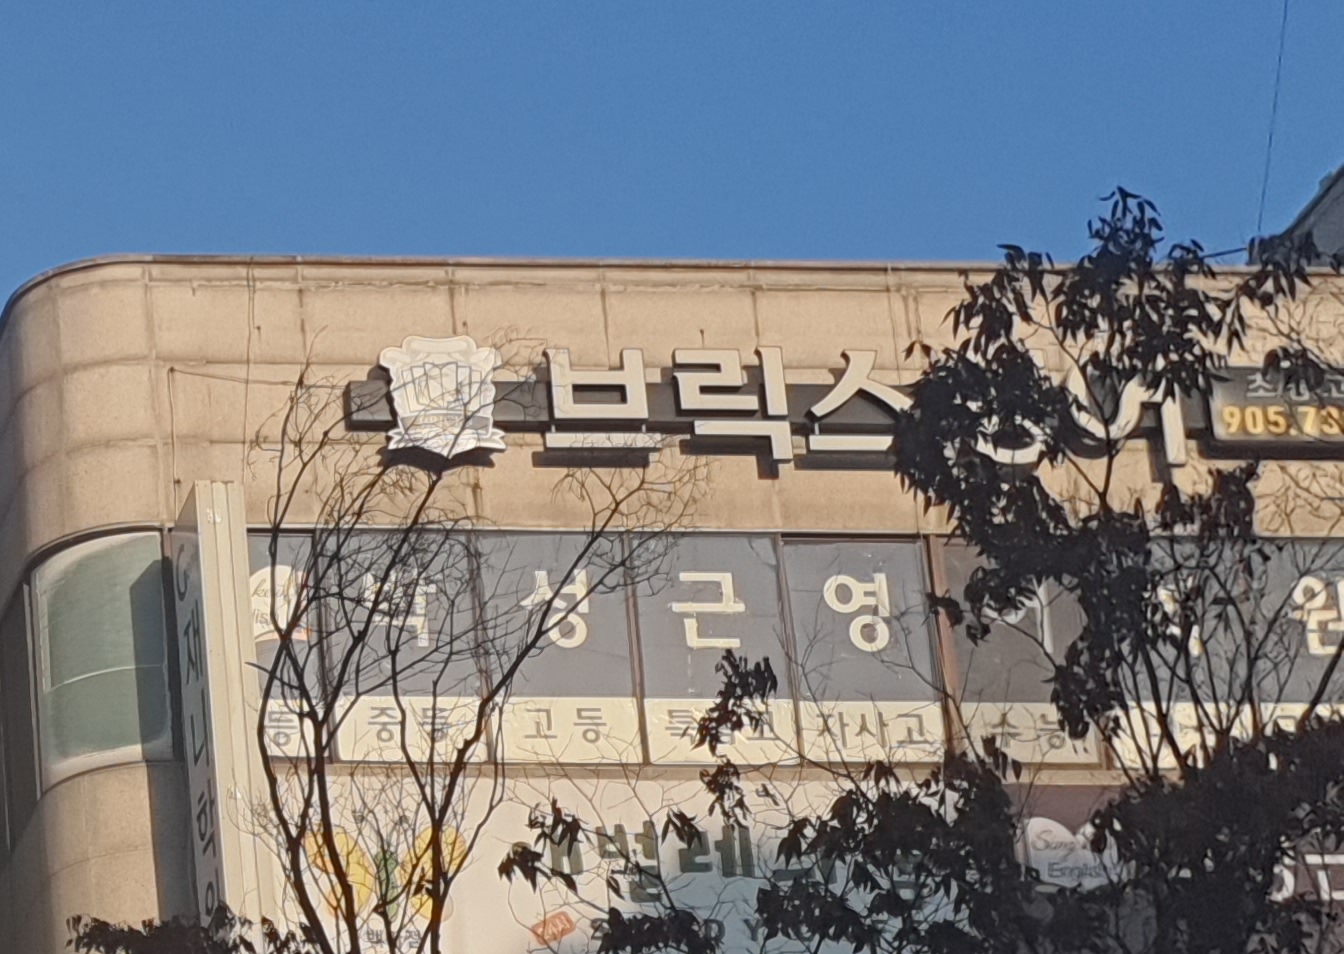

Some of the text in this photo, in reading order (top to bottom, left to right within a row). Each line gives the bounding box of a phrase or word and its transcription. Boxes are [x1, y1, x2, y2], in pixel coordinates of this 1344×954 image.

[542, 345, 1188, 466] 브릭스어
[1221, 404, 1344, 437] 905.73
[524, 706, 608, 745] 고등
[665, 707, 778, 747] 특고
[818, 710, 931, 752] 자사고
